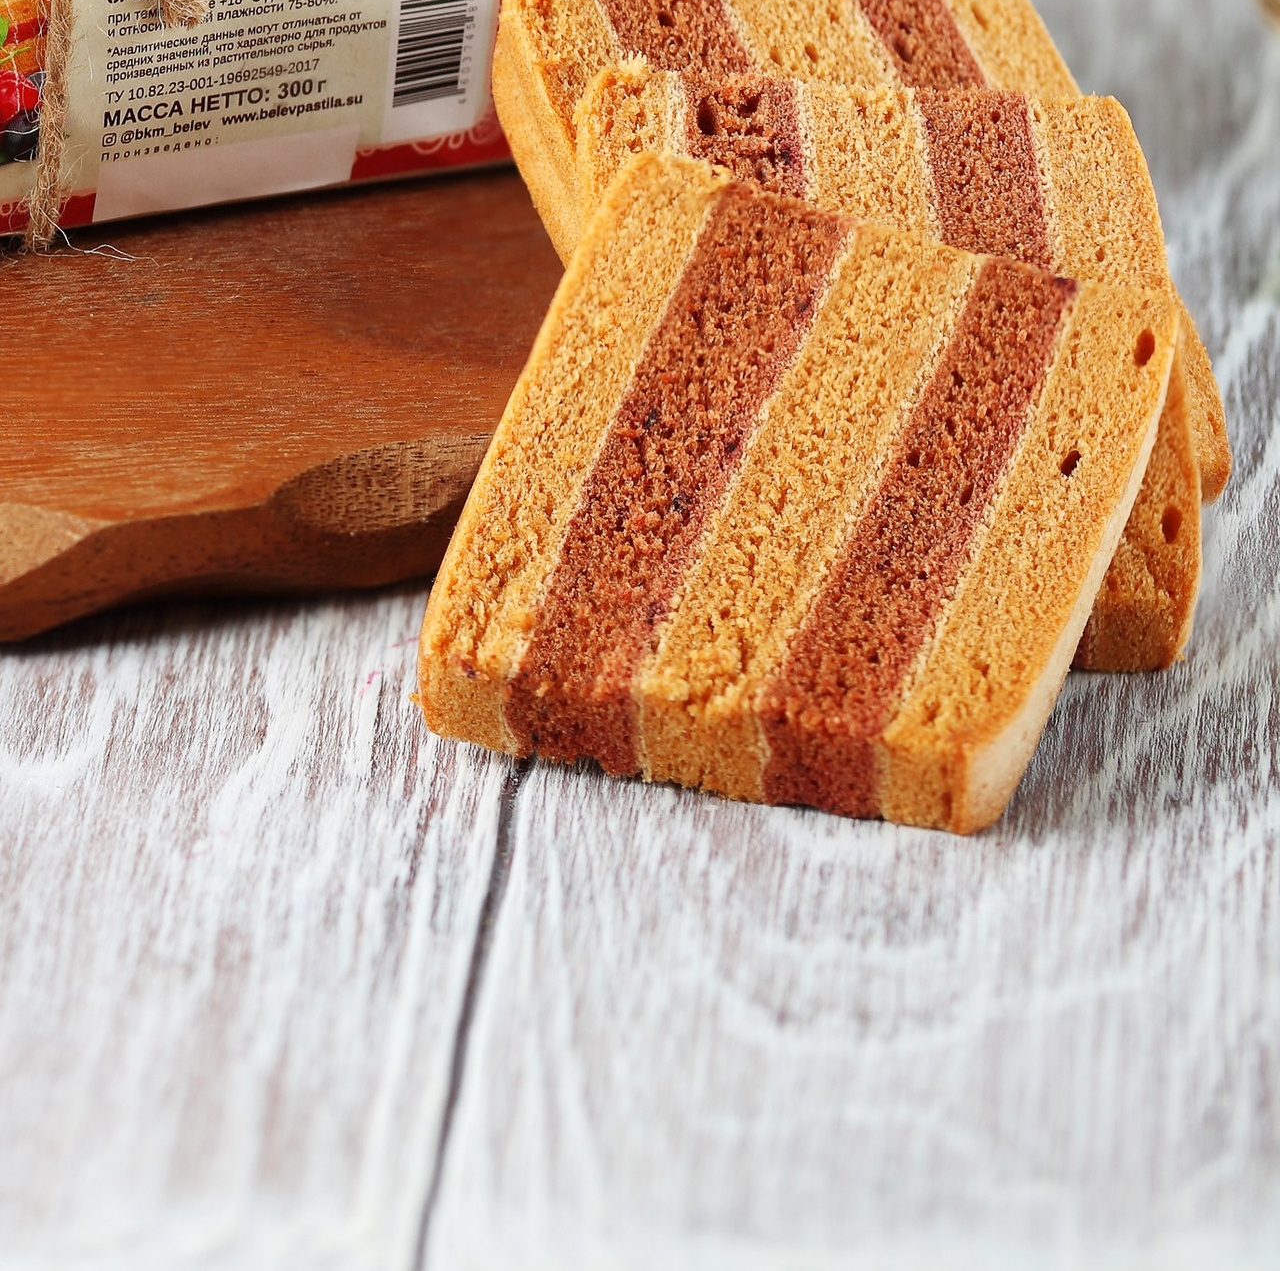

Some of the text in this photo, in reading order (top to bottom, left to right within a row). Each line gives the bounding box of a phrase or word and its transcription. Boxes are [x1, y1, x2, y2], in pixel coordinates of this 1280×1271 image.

[107, 28, 116, 38] и
[217, 2, 284, 22] влажности
[108, 12, 131, 26] при
[201, 27, 245, 46] данные
[248, 22, 279, 36] могут
[282, 13, 346, 30] отличаться
[349, 11, 362, 20] от
[106, 20, 387, 72] средних значений, что характерно для продуктов
[106, 38, 336, 84] произведенных из растительного сырья.
[103, 78, 327, 128] МАССА НЕТТО: 300 г
[106, 58, 320, 104] ТУ 10.82.23-001-19692549-2017
[120, 94, 363, 144] @bkm_belev www.belevpastila.su
